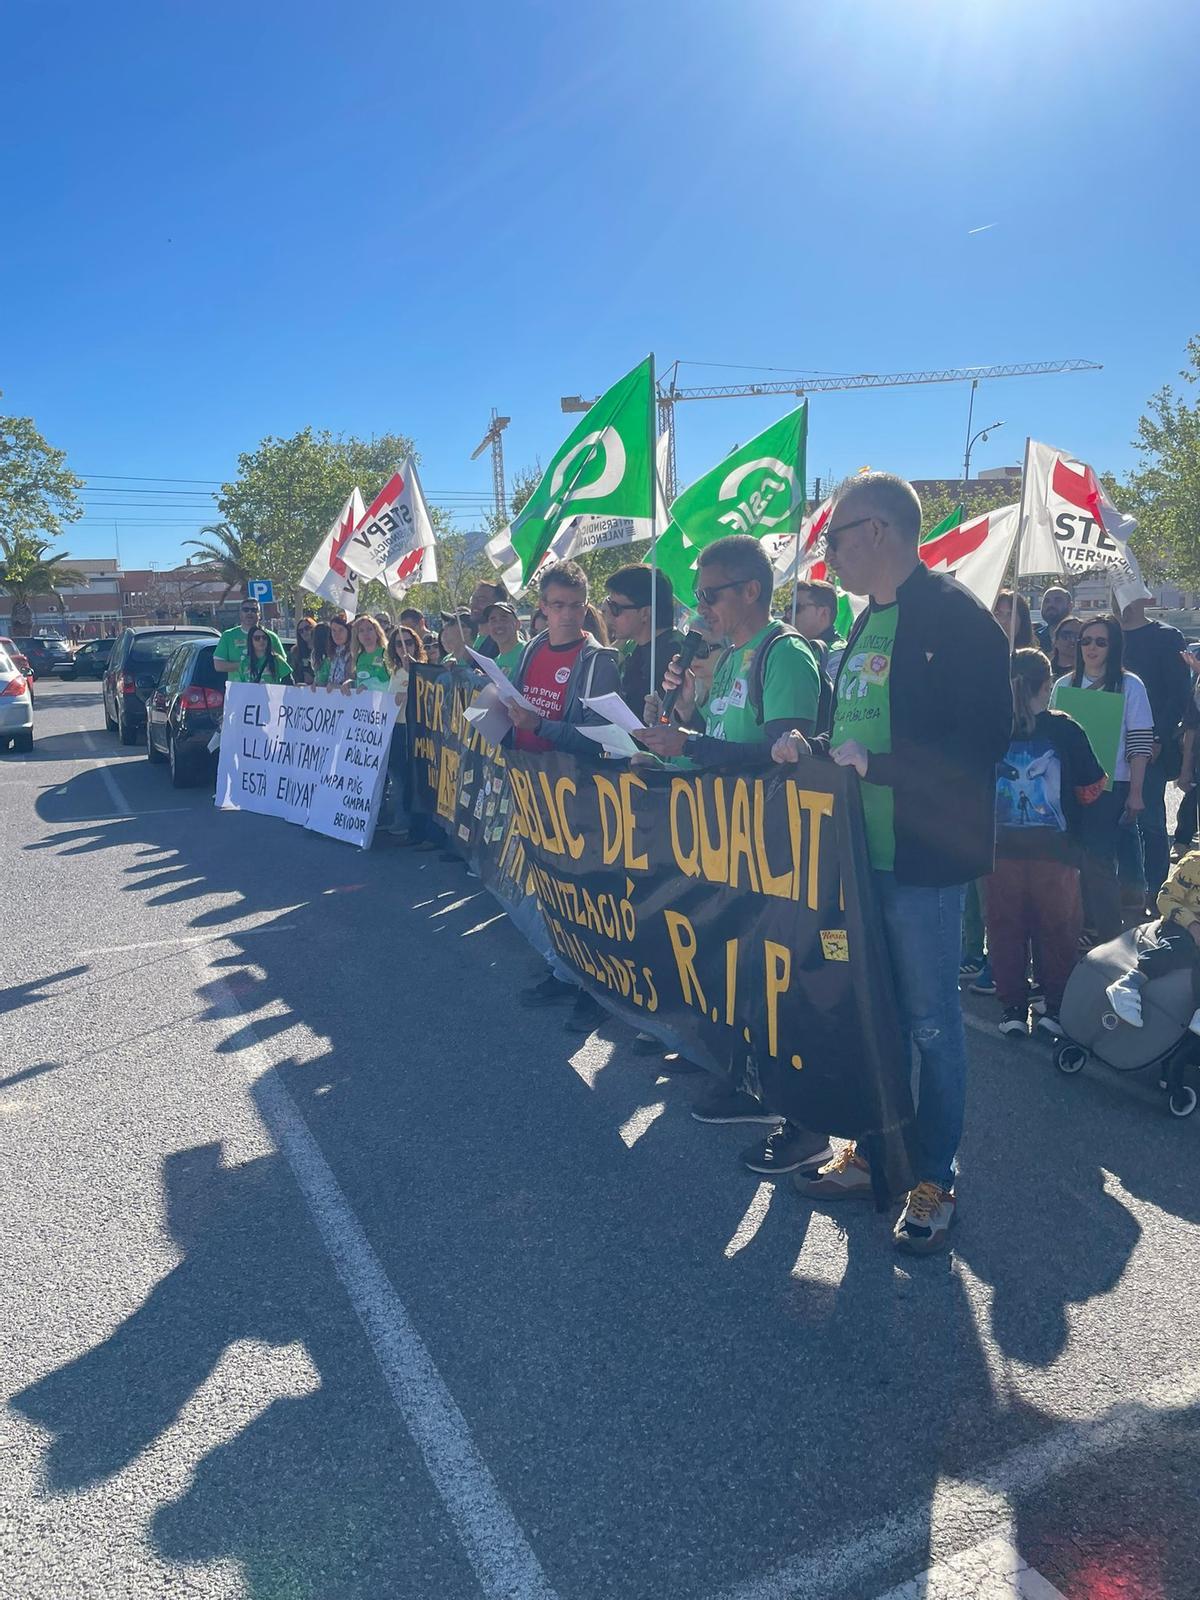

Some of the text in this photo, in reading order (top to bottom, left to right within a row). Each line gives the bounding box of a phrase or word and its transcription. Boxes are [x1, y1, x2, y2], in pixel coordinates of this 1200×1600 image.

[253, 582, 268, 601] P
[243, 705, 267, 727] EL
[345, 728, 384, 746] L'ESCOLA
[344, 744, 380, 771] PÚBLICA
[242, 770, 267, 797] ESTÀ
[592, 772, 648, 870] DE
[669, 776, 845, 911] QUALIT
